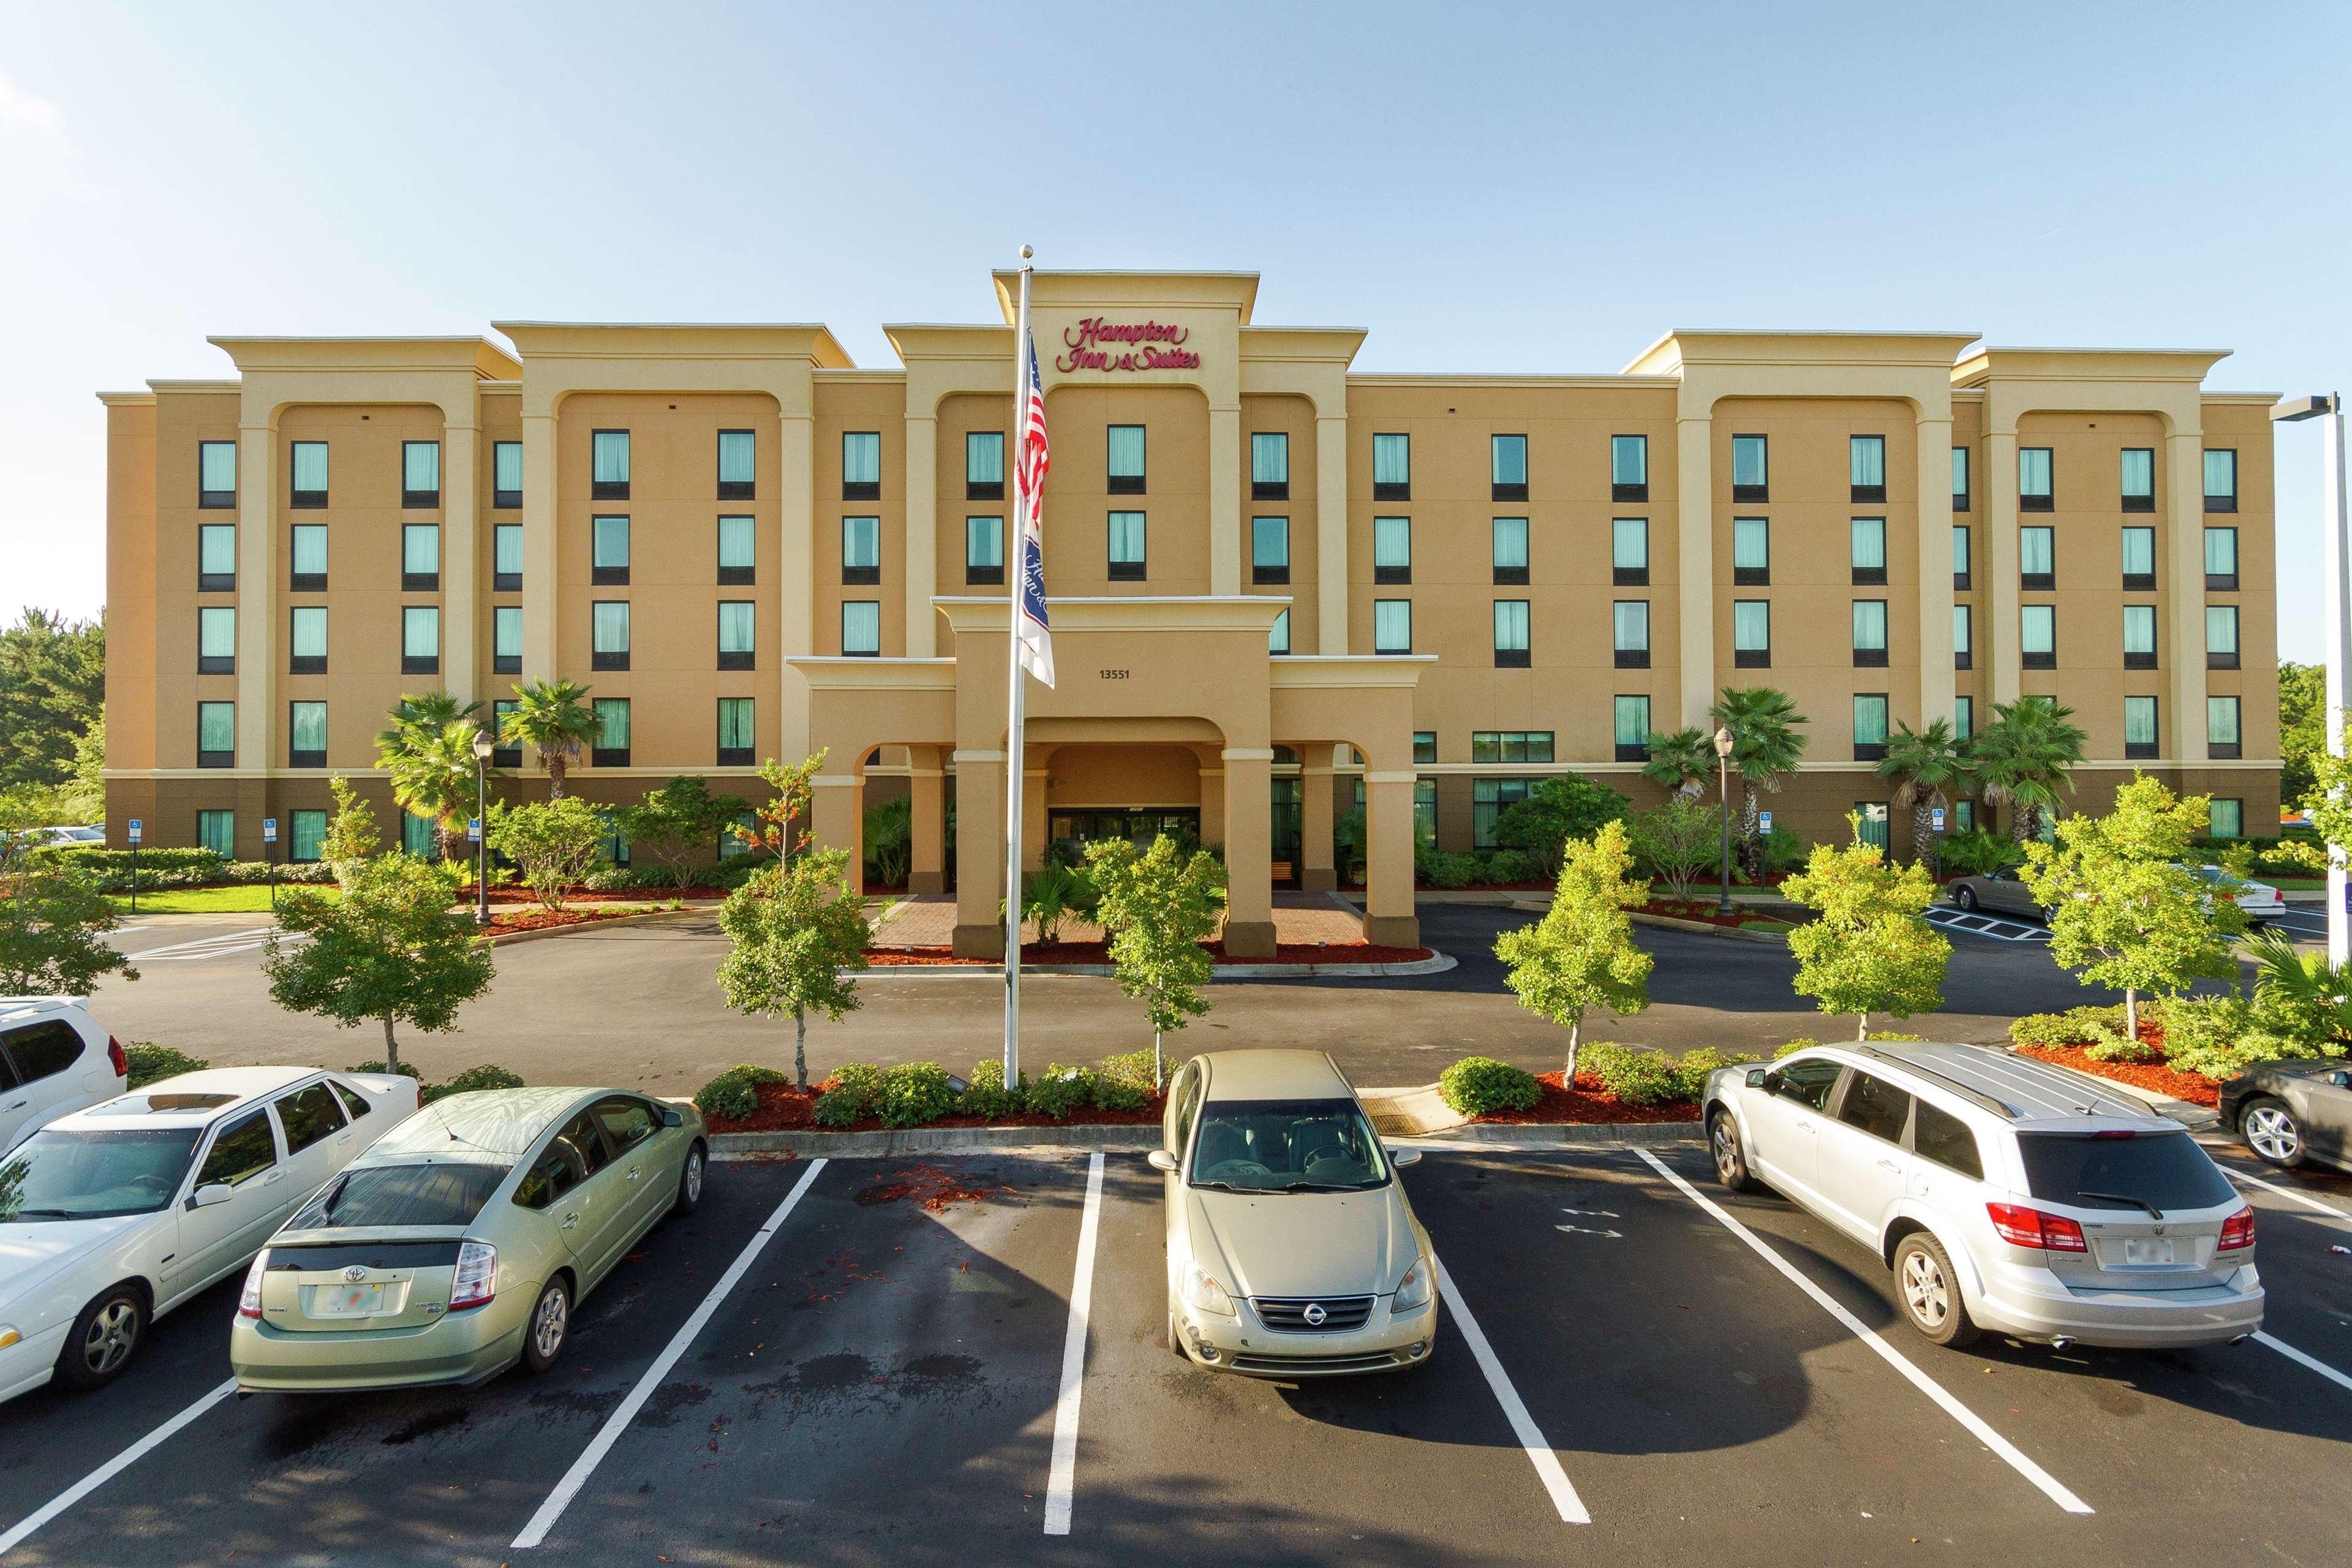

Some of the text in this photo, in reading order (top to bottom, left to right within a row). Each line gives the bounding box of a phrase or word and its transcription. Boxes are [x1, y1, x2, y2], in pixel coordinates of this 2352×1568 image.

[1064, 316, 1188, 348] Hampton
[1055, 345, 1200, 373] Inn & Suites
[1099, 669, 1129, 679] 13551
